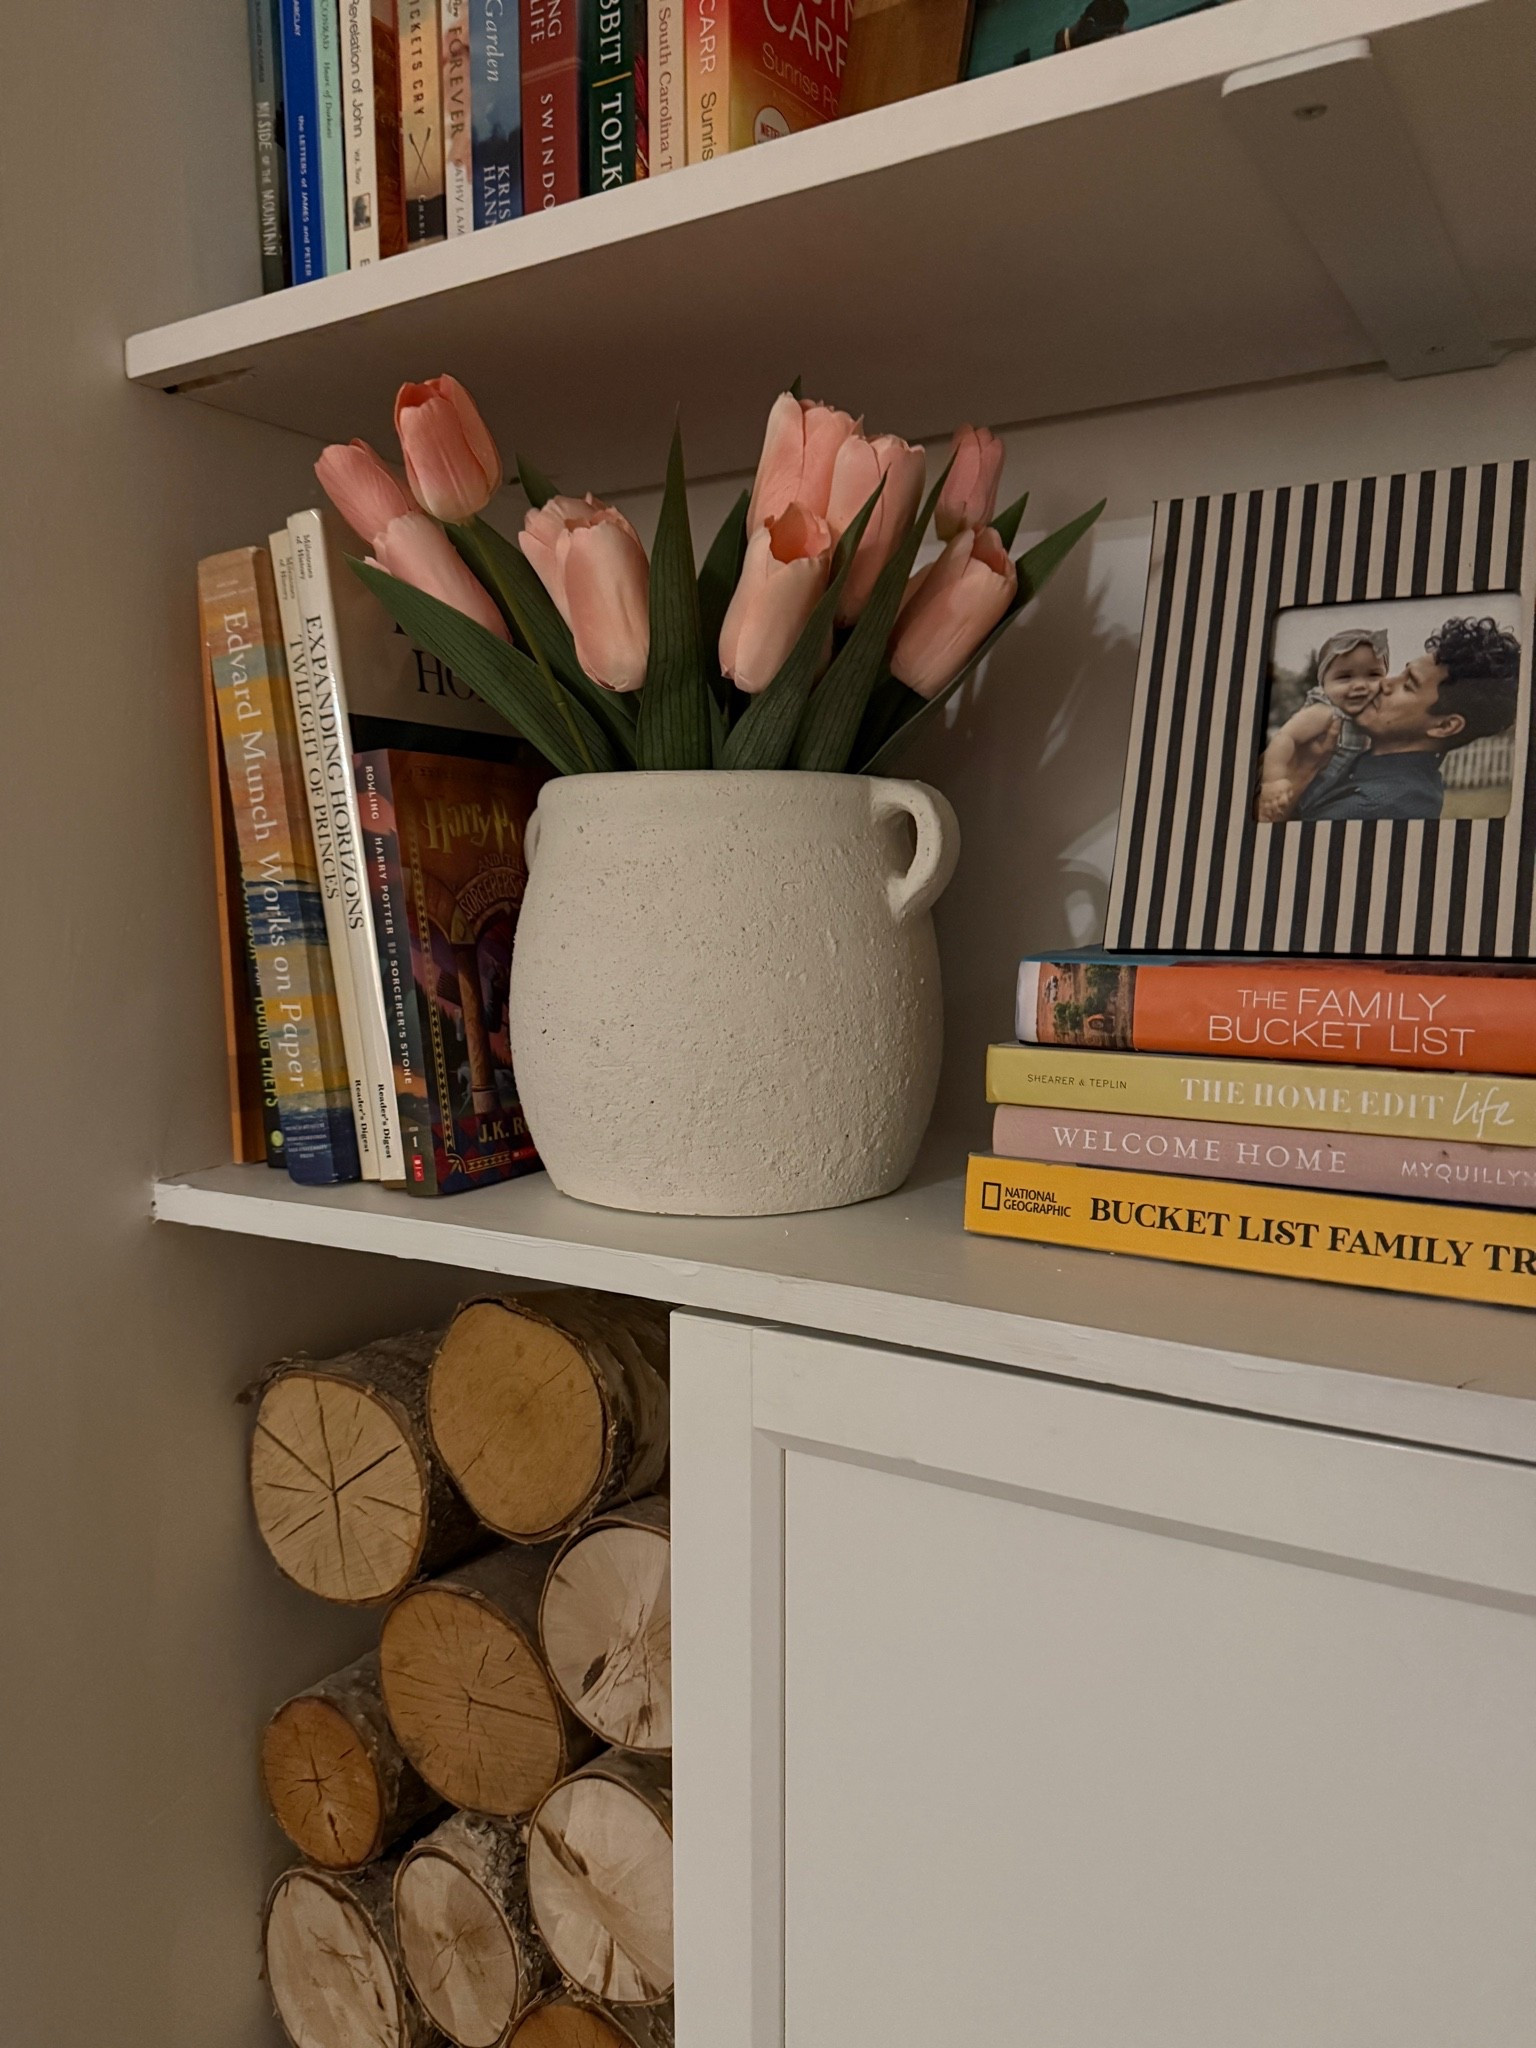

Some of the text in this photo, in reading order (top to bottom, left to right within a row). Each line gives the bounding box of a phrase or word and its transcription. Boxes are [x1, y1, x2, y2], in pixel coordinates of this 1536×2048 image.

[485, 0, 505, 82] Garden
[658, 7, 672, 67] South
[699, 0, 716, 75] CARR
[352, 79, 363, 95] of
[448, 26, 465, 139] FOREVER
[762, 42, 820, 101] Sunrise
[353, 99, 364, 138] John
[412, 79, 425, 115] CRY
[659, 71, 673, 153] Carolina
[257, 120, 273, 150] SIDE
[299, 134, 308, 175] LETTERS
[262, 189, 277, 256] MOUNTAIN
[302, 192, 310, 222] JAMES
[303, 226, 311, 244] and
[304, 247, 313, 277] PETER
[223, 608, 262, 721] Edvard
[240, 729, 277, 842] Munch
[289, 634, 339, 900] TWILIGHT OF PRINCES
[306, 614, 364, 930] EXPANDING HORIZONS
[365, 765, 380, 820] ROWLING
[420, 798, 491, 854] Harry
[374, 837, 388, 880] HARRY
[258, 851, 291, 946] Works
[380, 885, 394, 935] POTTER
[274, 956, 292, 992] on
[390, 959, 407, 1038] SORCERER'S
[400, 1042, 412, 1085] STONE
[1236, 988, 1447, 1022] THE FAMILY
[277, 1001, 305, 1088] Paper
[1208, 1015, 1476, 1056] BUCKET LIST
[1027, 1073, 1128, 1089] SHEARER & TEPLIN
[479, 1119, 509, 1143] J.K.
[1181, 1078, 1515, 1139] THE HOME EDIT life
[382, 1127, 392, 1159] Digest
[1052, 1126, 1221, 1161] WELCOME
[1236, 1142, 1347, 1173] HOME
[1003, 1199, 1072, 1217] GEOGRAPHIC
[1004, 1186, 1057, 1204] NATIONAL
[1089, 1197, 1536, 1275] BUCKET LIST FAMILY TR
